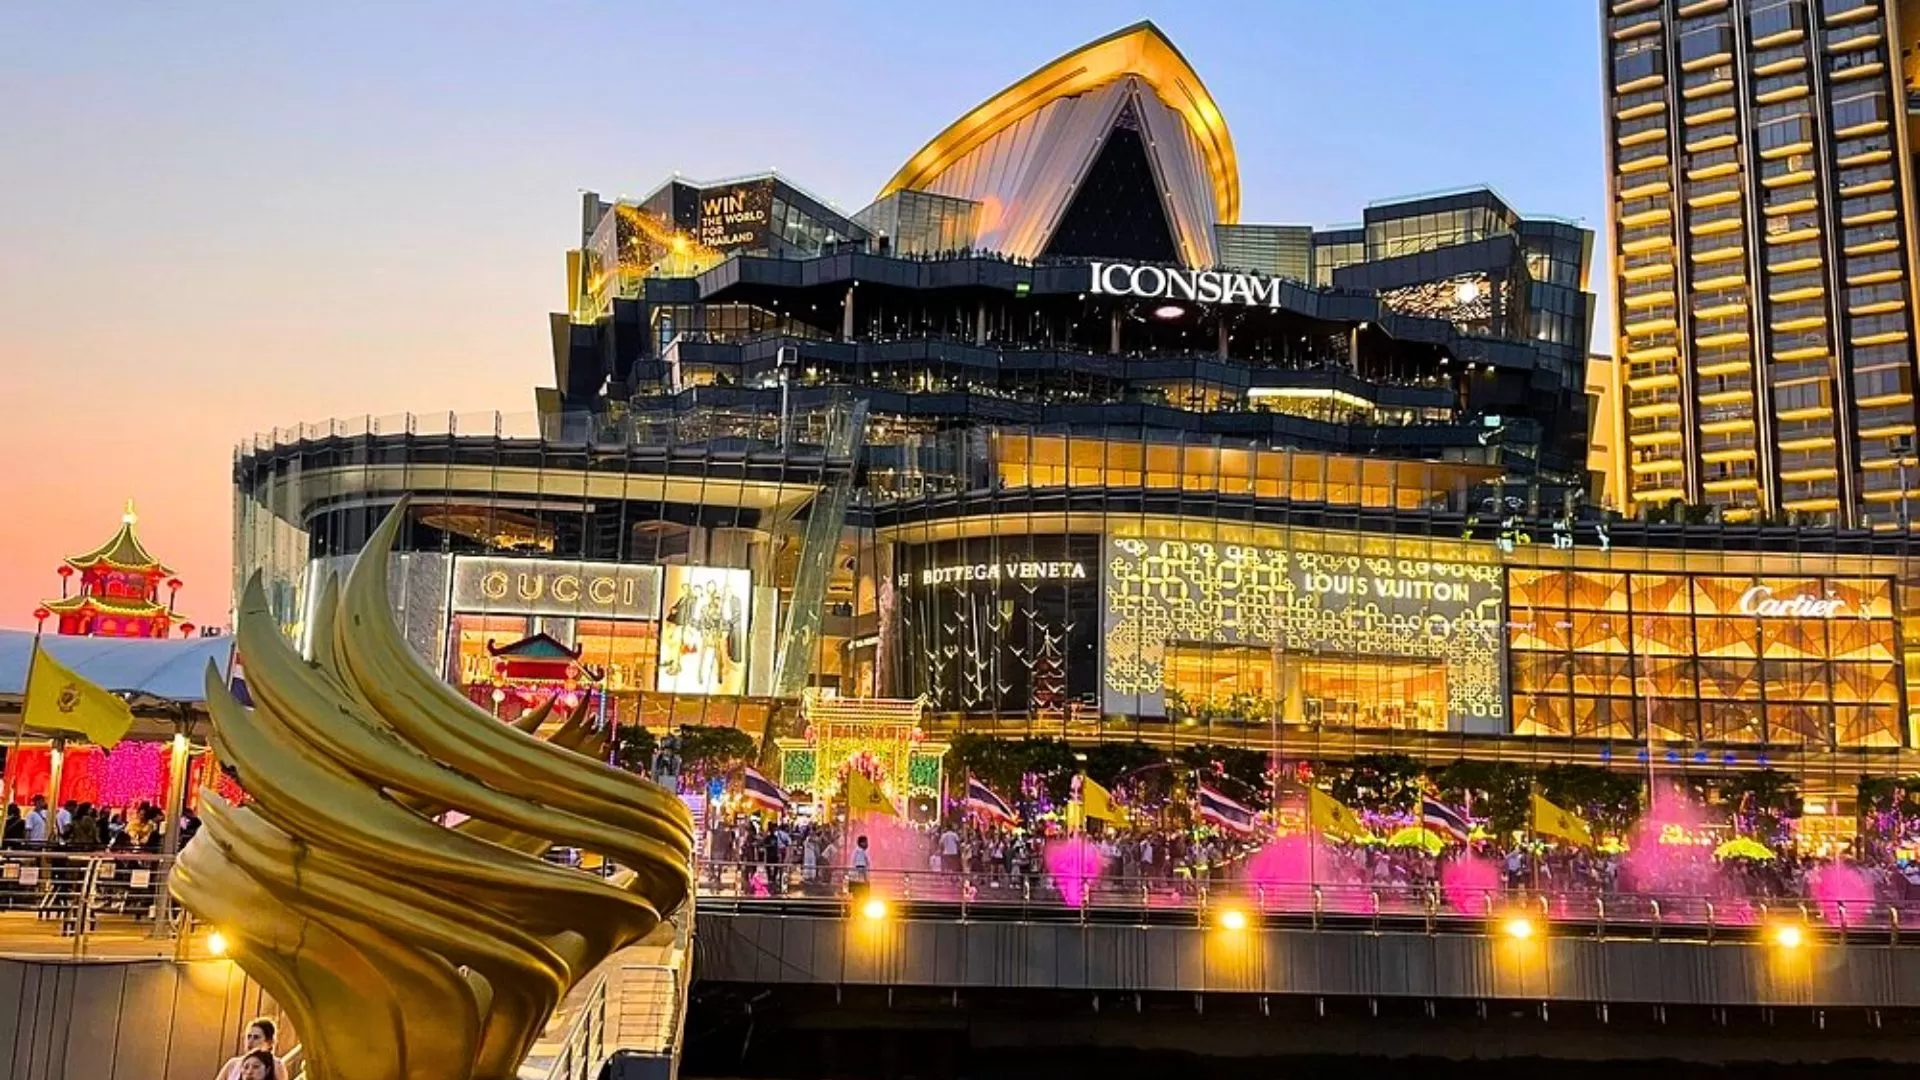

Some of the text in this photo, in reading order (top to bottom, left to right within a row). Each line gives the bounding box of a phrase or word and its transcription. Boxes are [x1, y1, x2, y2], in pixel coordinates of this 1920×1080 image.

[702, 195, 745, 215] WIN
[701, 210, 765, 227] THE WORLD
[702, 226, 724, 237] FOR
[702, 231, 754, 246] THAILAND
[1090, 262, 1282, 308] ICONSIAM
[923, 564, 1000, 585] BOTTEGA
[1006, 562, 1086, 579] VENETA
[480, 571, 635, 606] GUCCI
[1304, 574, 1470, 602] LOUIS VUITTON
[1739, 585, 1846, 617] Cartier
